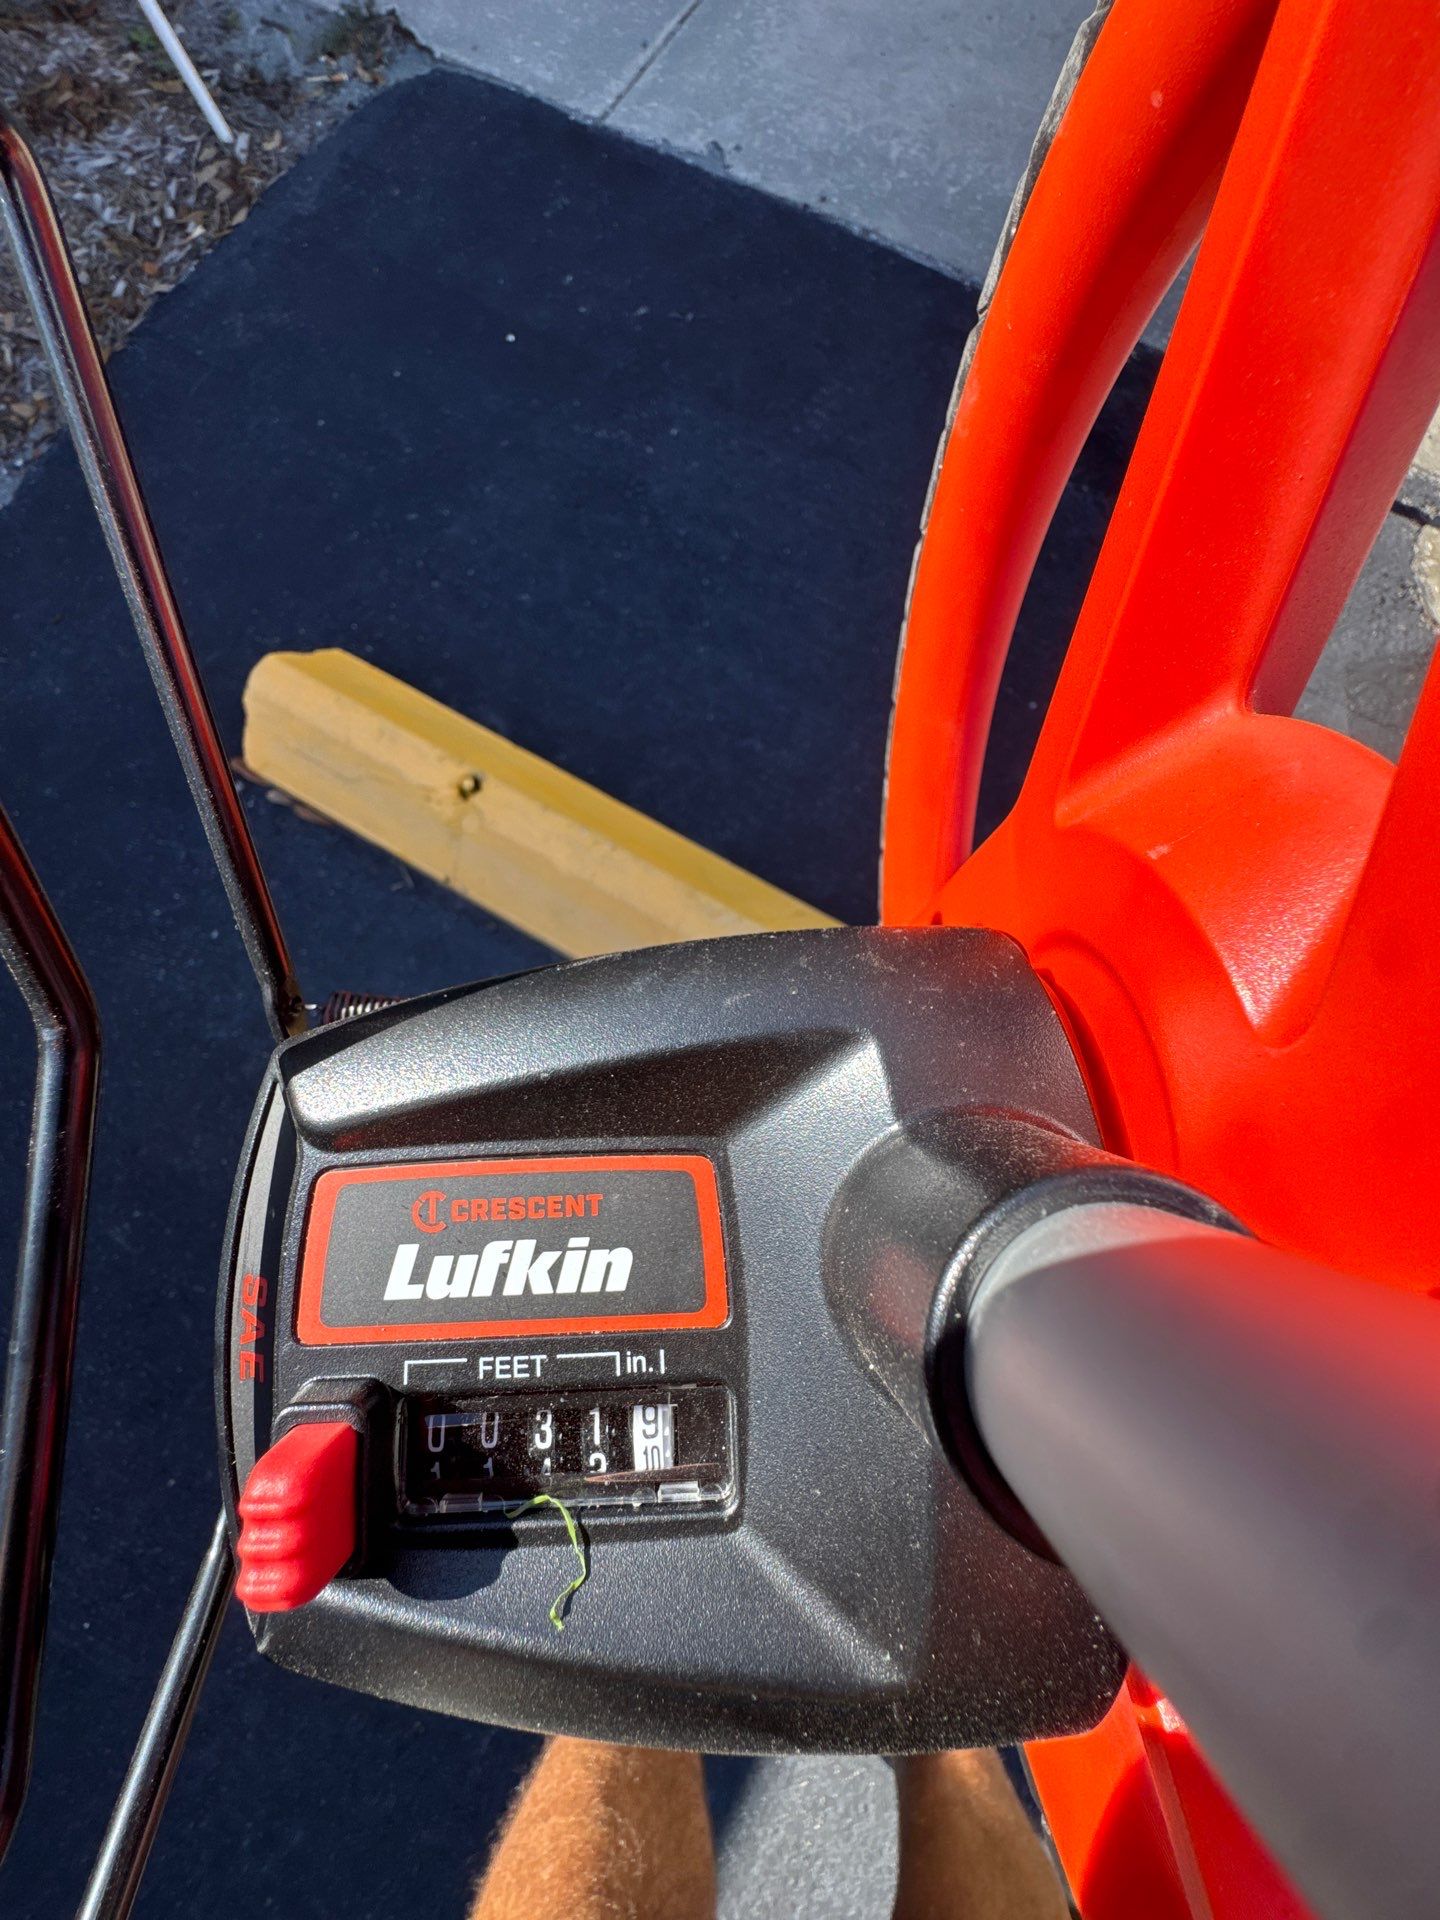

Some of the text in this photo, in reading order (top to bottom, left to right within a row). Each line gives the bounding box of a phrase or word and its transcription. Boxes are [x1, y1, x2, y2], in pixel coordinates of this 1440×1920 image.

[450, 1193, 603, 1223] CRESCENT
[383, 1236, 634, 1301] Lufkin
[239, 1273, 268, 1383] SAE
[478, 1354, 547, 1380] FEET
